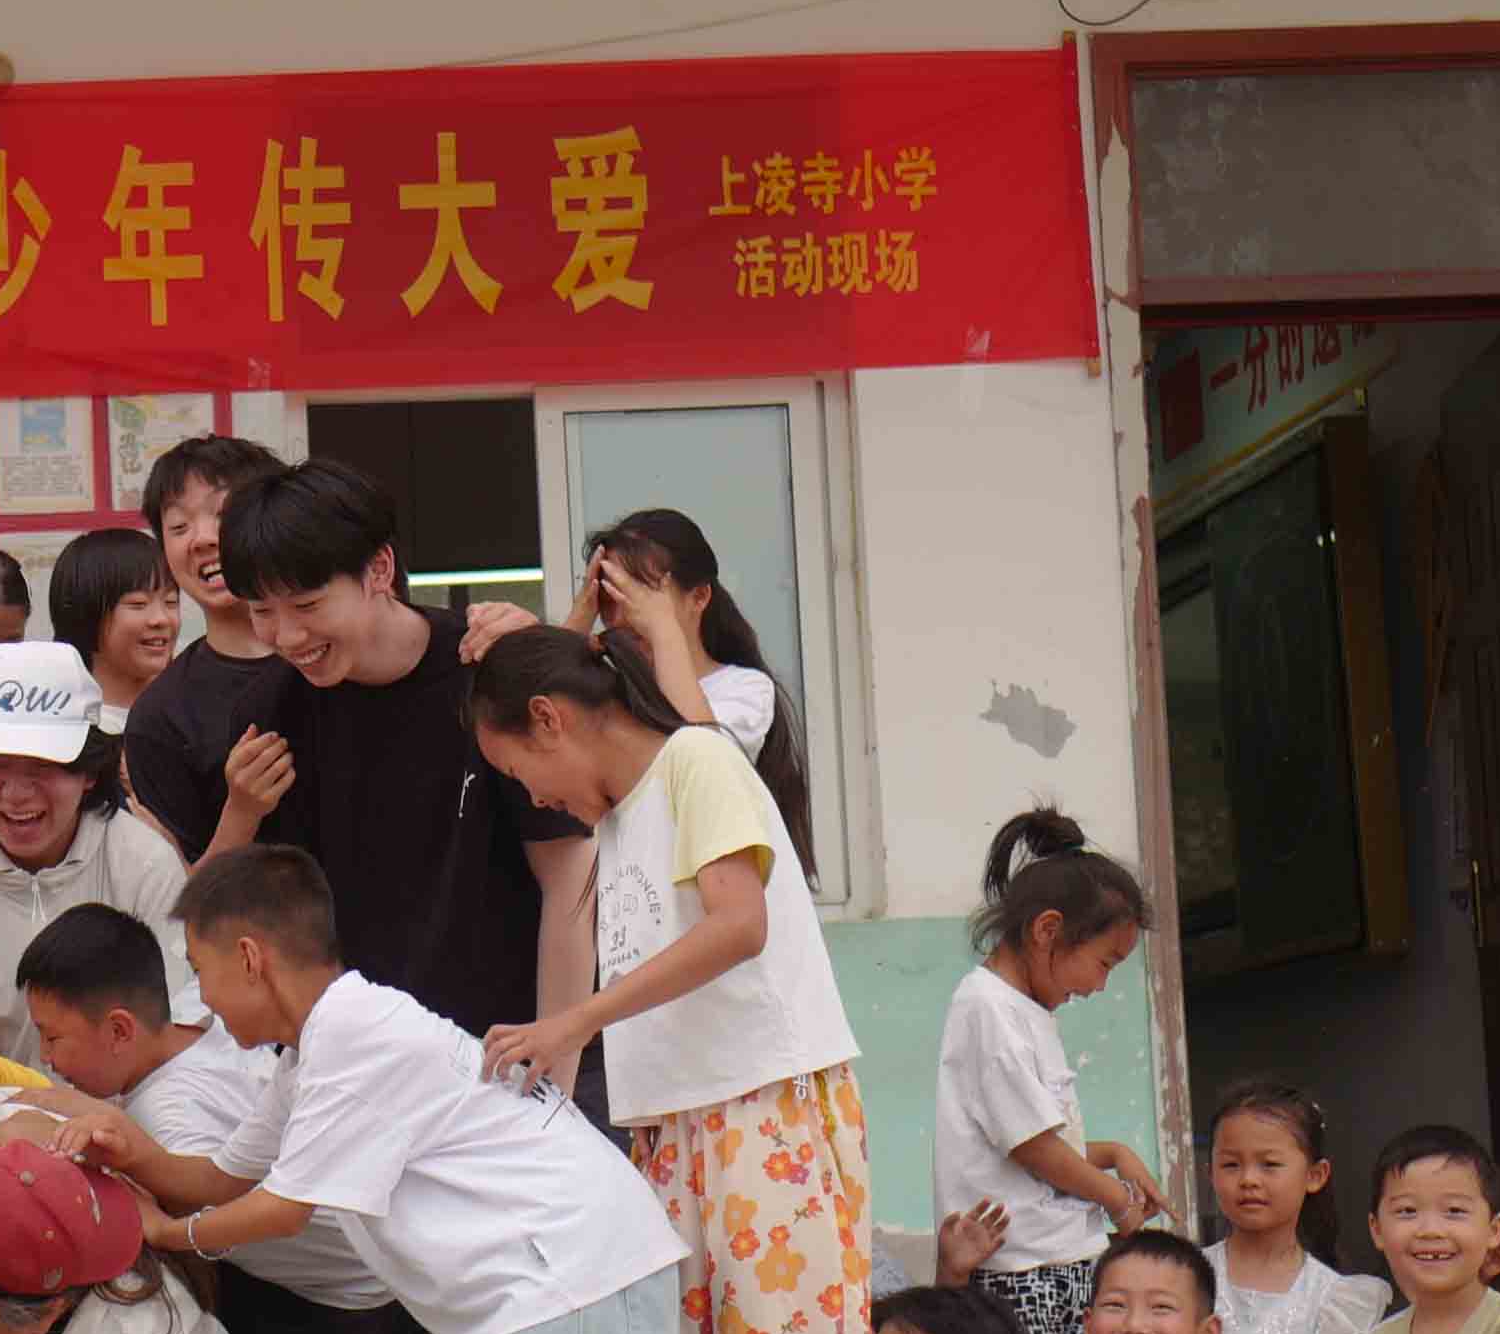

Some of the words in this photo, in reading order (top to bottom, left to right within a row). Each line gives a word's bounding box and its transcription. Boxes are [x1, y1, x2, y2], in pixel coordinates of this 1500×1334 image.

[708, 146, 938, 217] 上凌寺小学
[732, 229, 921, 298] 活动现场
